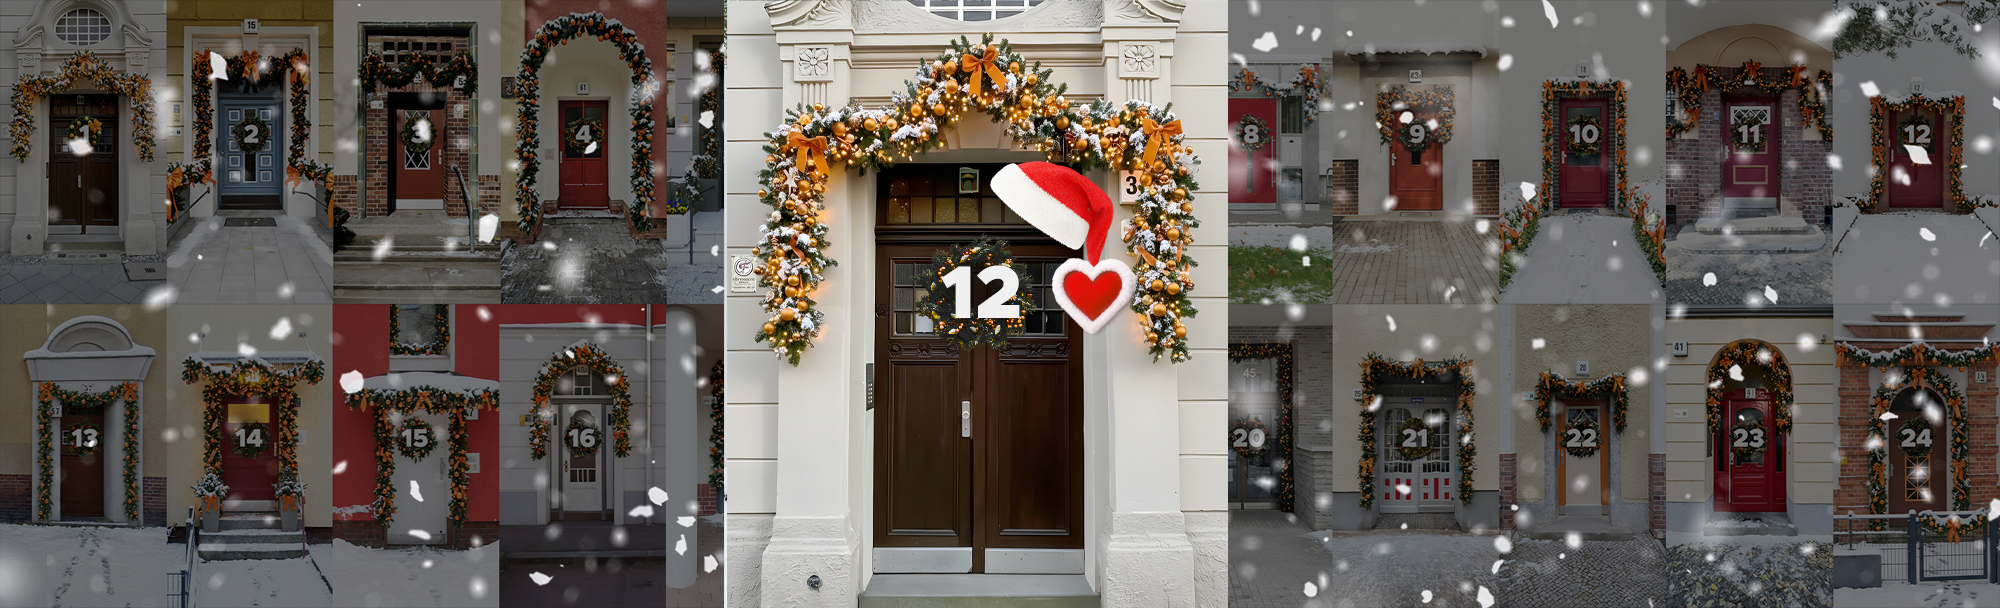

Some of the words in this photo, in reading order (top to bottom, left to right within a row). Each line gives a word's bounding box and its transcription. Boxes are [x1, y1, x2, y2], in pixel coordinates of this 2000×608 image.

[248, 21, 256, 29] 15
[1126, 176, 1137, 195] 3
[1674, 342, 1683, 351] 41
[1579, 363, 1587, 371] 20
[1243, 368, 1256, 377] 45
